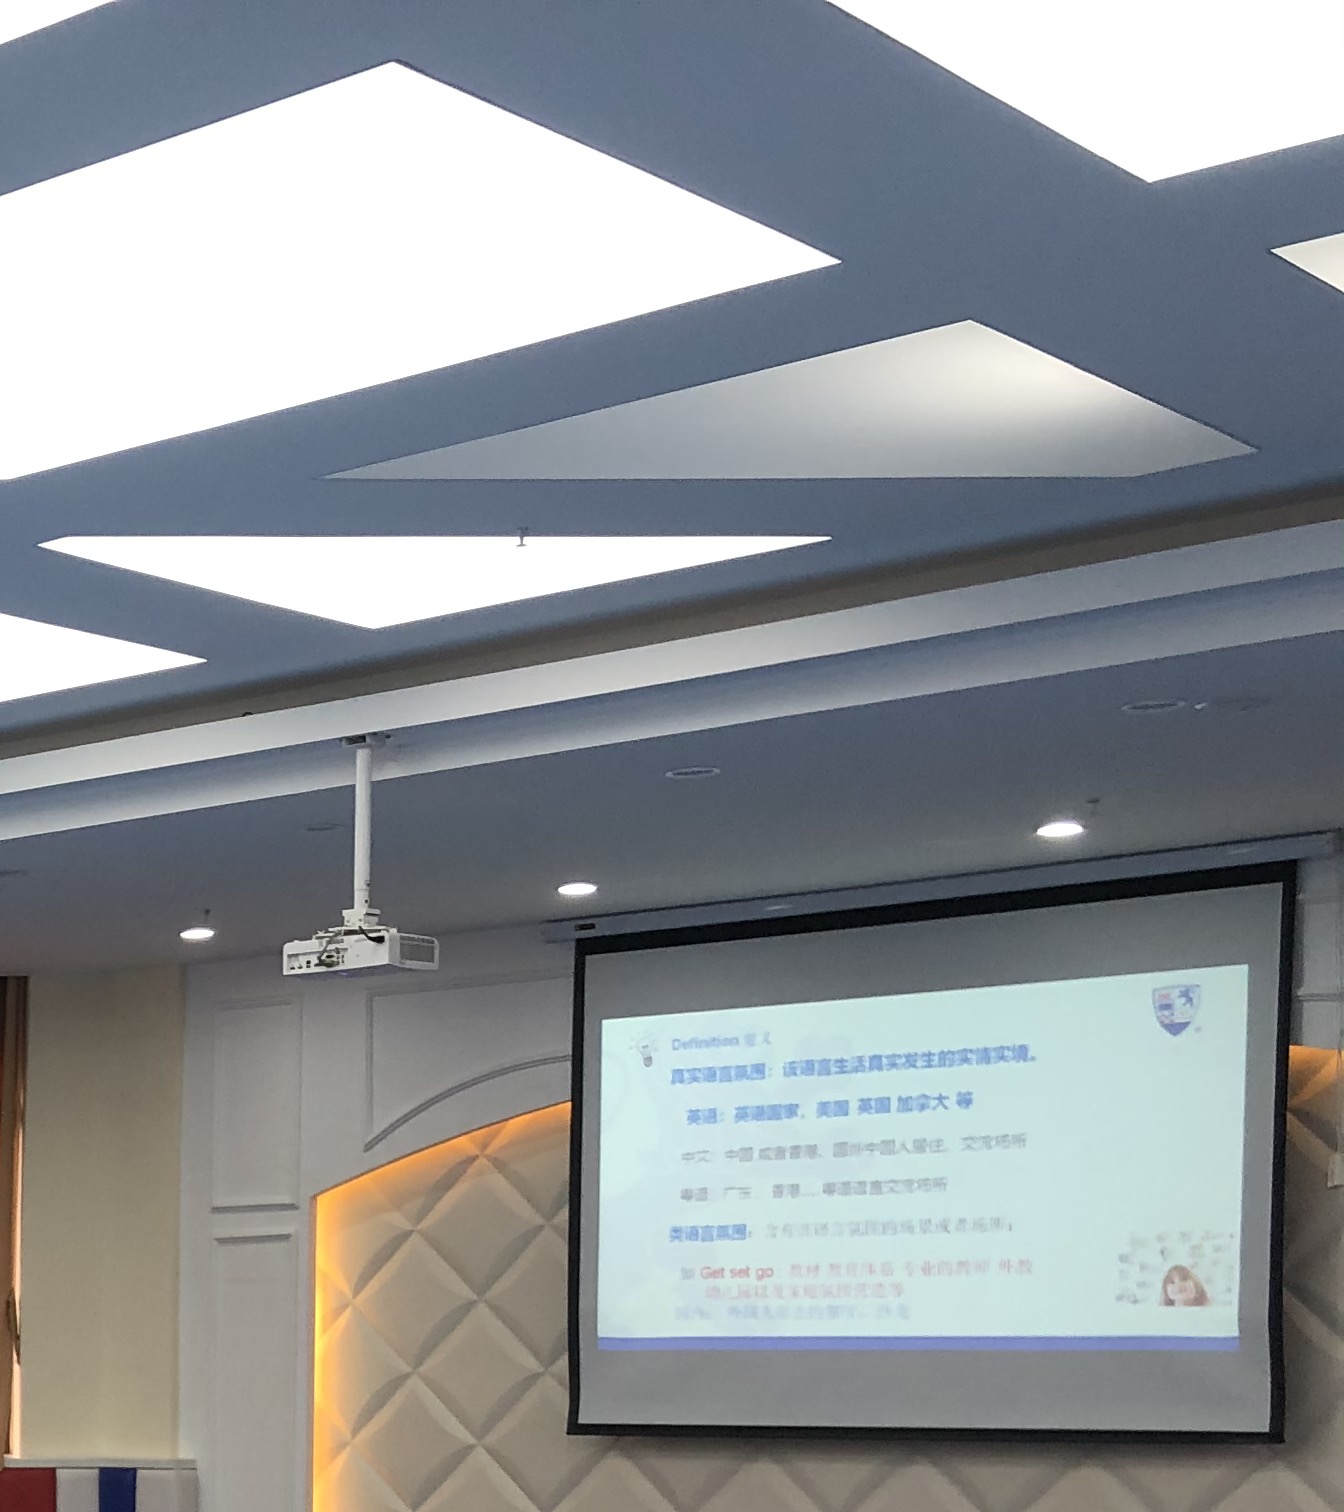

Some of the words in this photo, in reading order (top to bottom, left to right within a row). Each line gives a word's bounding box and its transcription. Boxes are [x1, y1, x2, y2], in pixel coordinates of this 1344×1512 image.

[671, 1036, 740, 1051] Definition
[699, 1266, 725, 1280] Get
[729, 1266, 751, 1279] set
